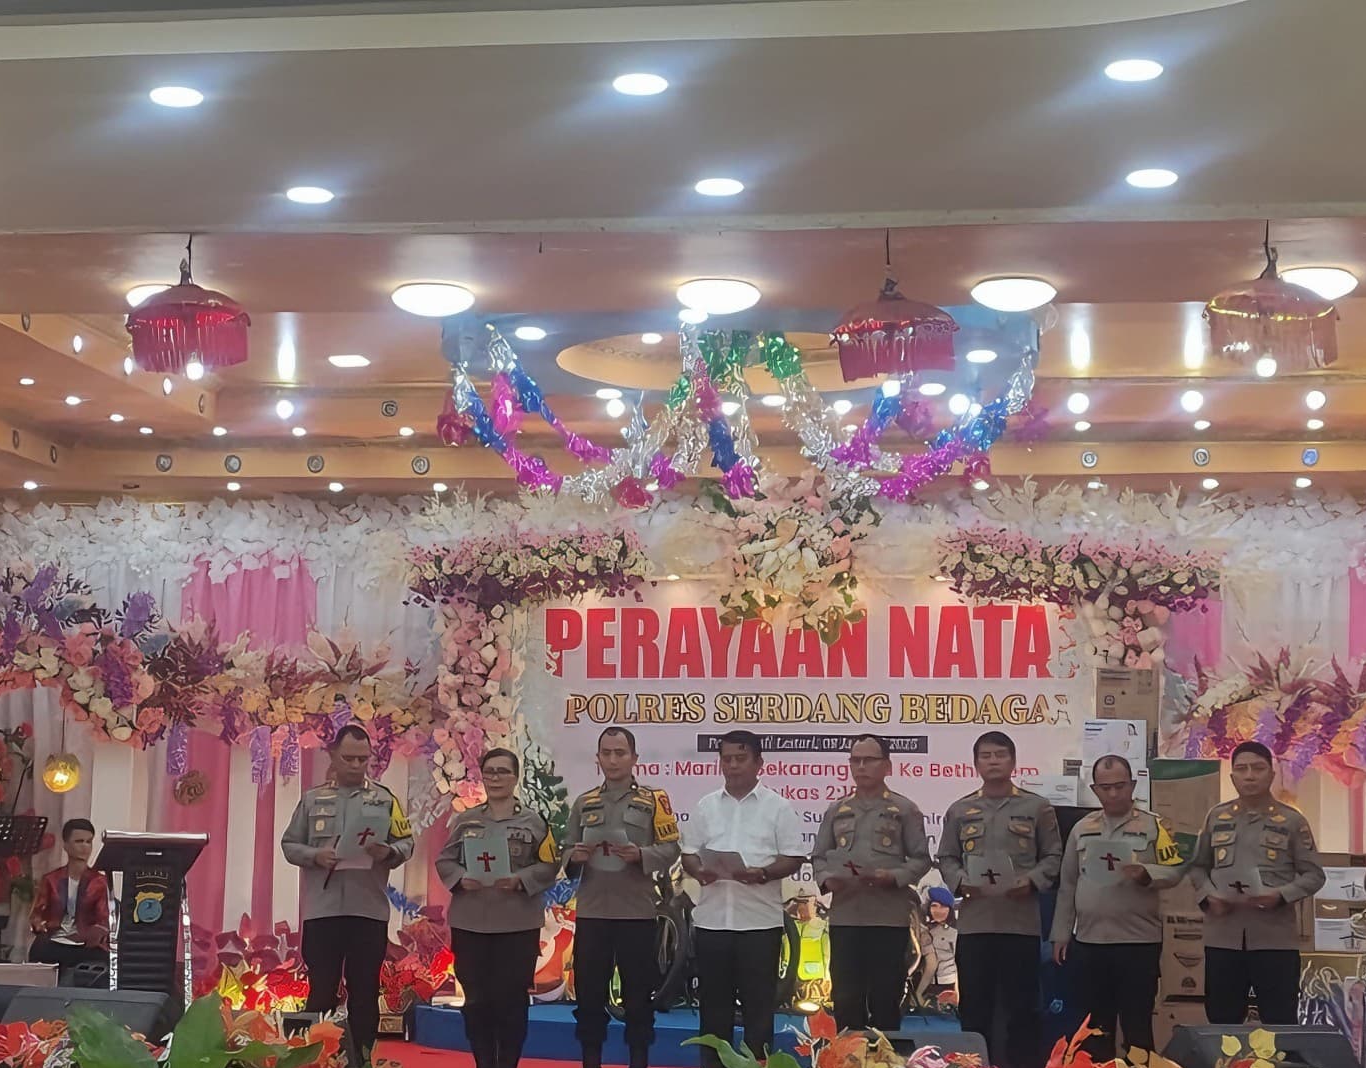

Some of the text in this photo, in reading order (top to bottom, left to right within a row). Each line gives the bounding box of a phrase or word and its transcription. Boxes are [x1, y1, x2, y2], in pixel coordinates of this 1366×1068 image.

[546, 605, 1078, 678] PERAYAAN NATA
[564, 693, 705, 725] POLRES
[714, 692, 891, 724] SERDANG
[900, 762, 924, 777] Ke
